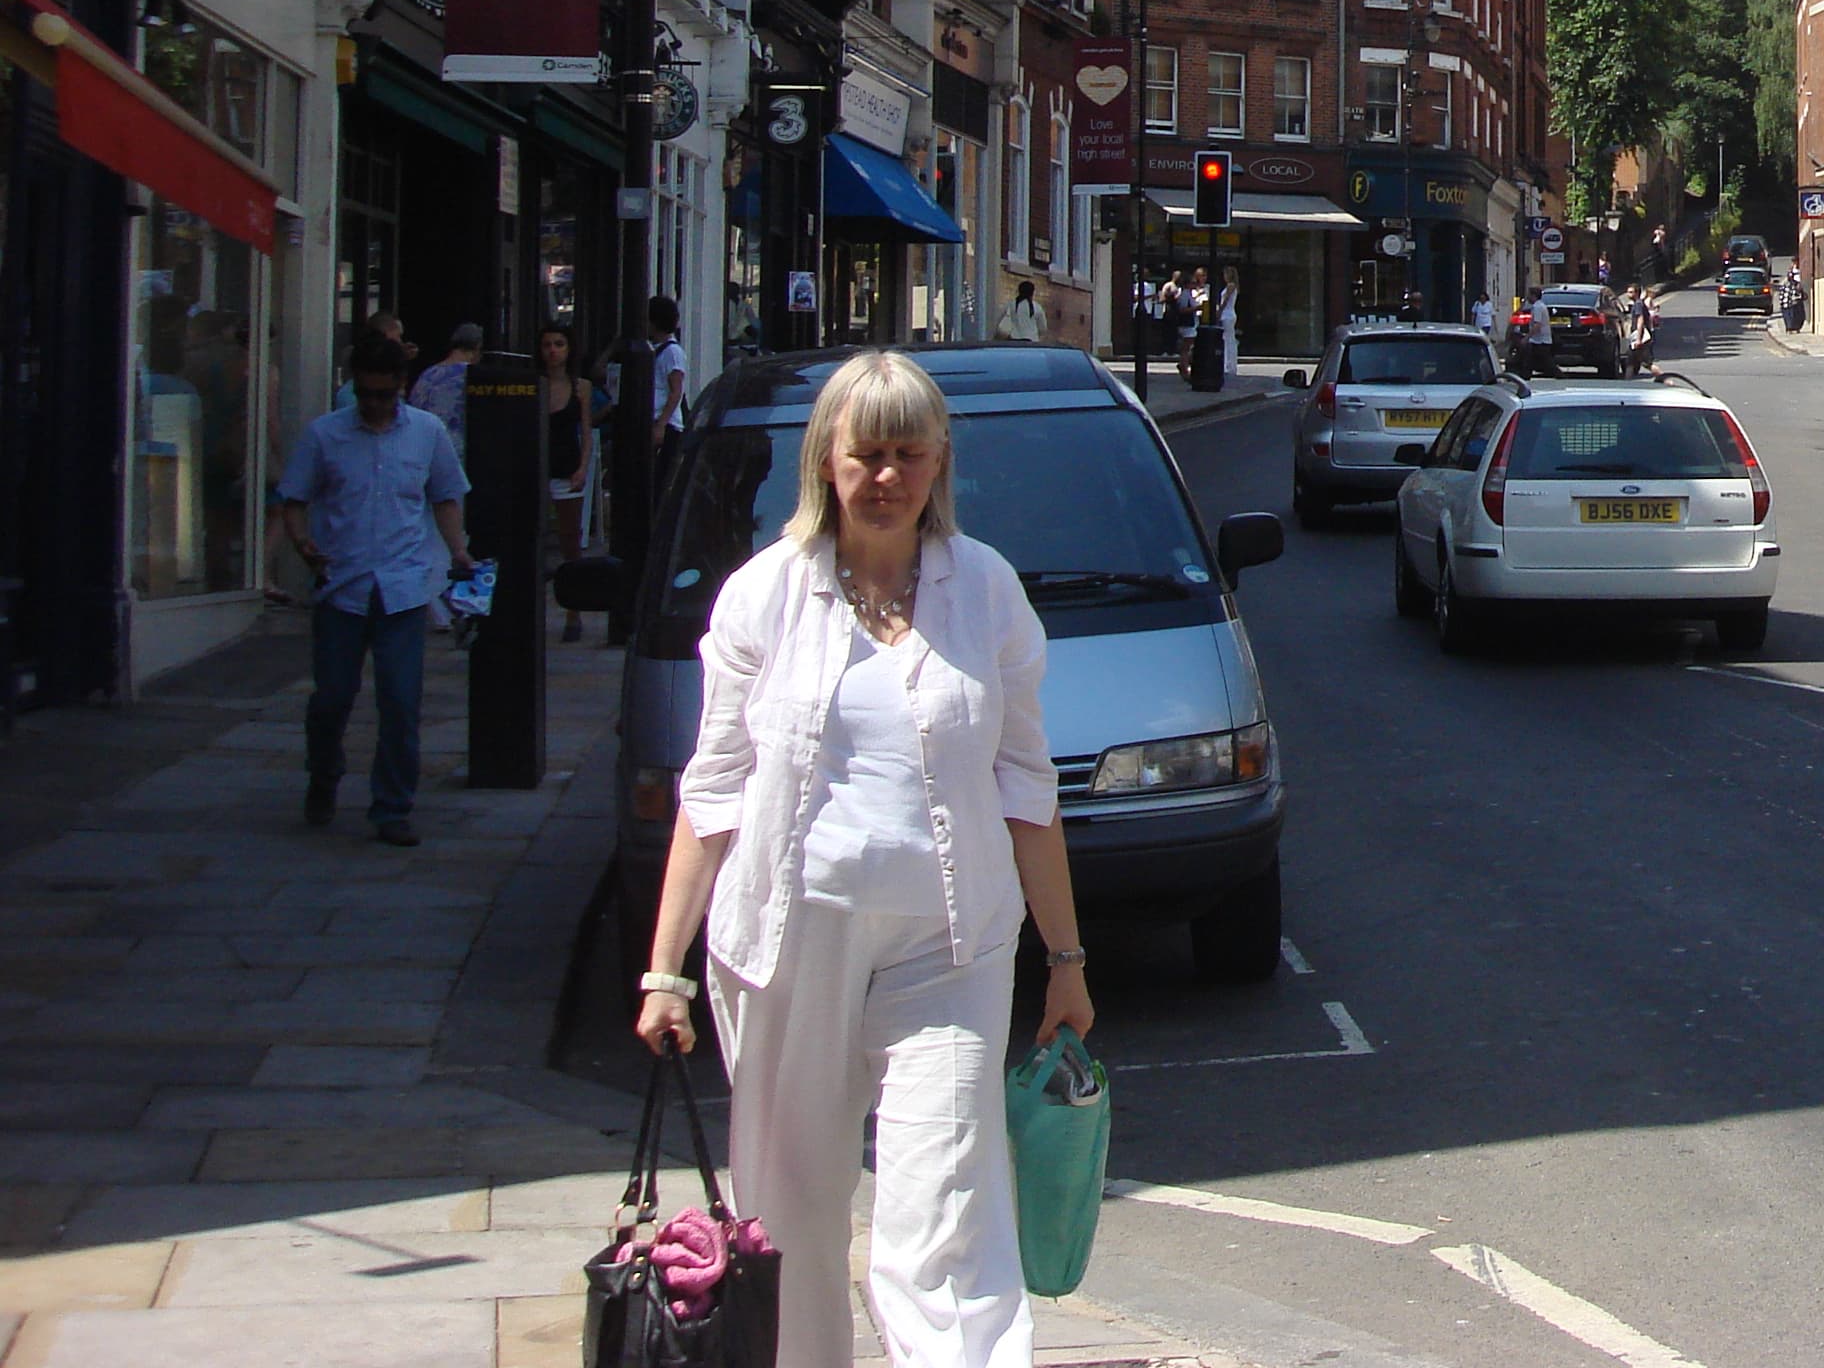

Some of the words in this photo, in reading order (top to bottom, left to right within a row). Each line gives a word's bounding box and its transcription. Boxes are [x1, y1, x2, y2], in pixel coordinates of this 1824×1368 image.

[768, 95, 808, 144] 3
[1090, 119, 1114, 131] Love
[1079, 134, 1100, 146] your
[1102, 133, 1124, 145] local
[1077, 148, 1098, 161] high
[1100, 147, 1126, 160] street
[1262, 165, 1300, 177] LOCAL
[467, 384, 494, 396] PAY
[496, 384, 537, 396] HERE
[1588, 504, 1634, 521] BJ56
[1639, 503, 1673, 520] DXE
